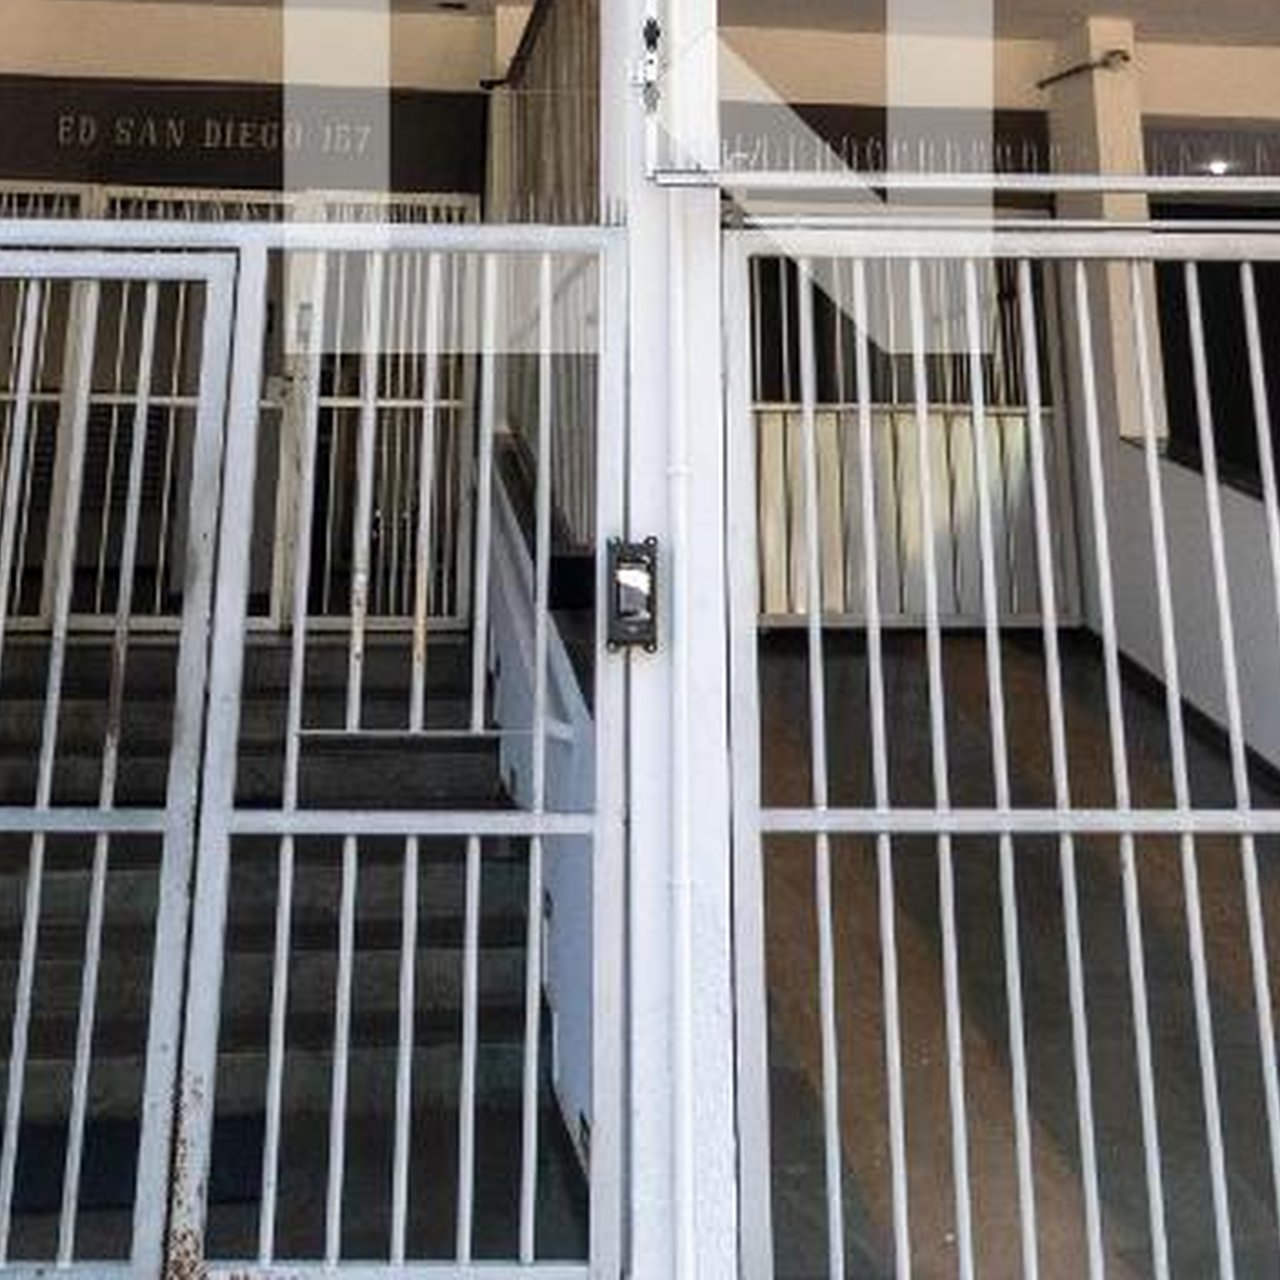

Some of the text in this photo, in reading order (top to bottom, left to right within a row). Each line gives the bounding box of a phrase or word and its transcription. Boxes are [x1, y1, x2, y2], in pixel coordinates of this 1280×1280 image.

[57, 114, 98, 146] ED
[114, 116, 186, 148] SAN
[203, 118, 303, 150] DIEGO
